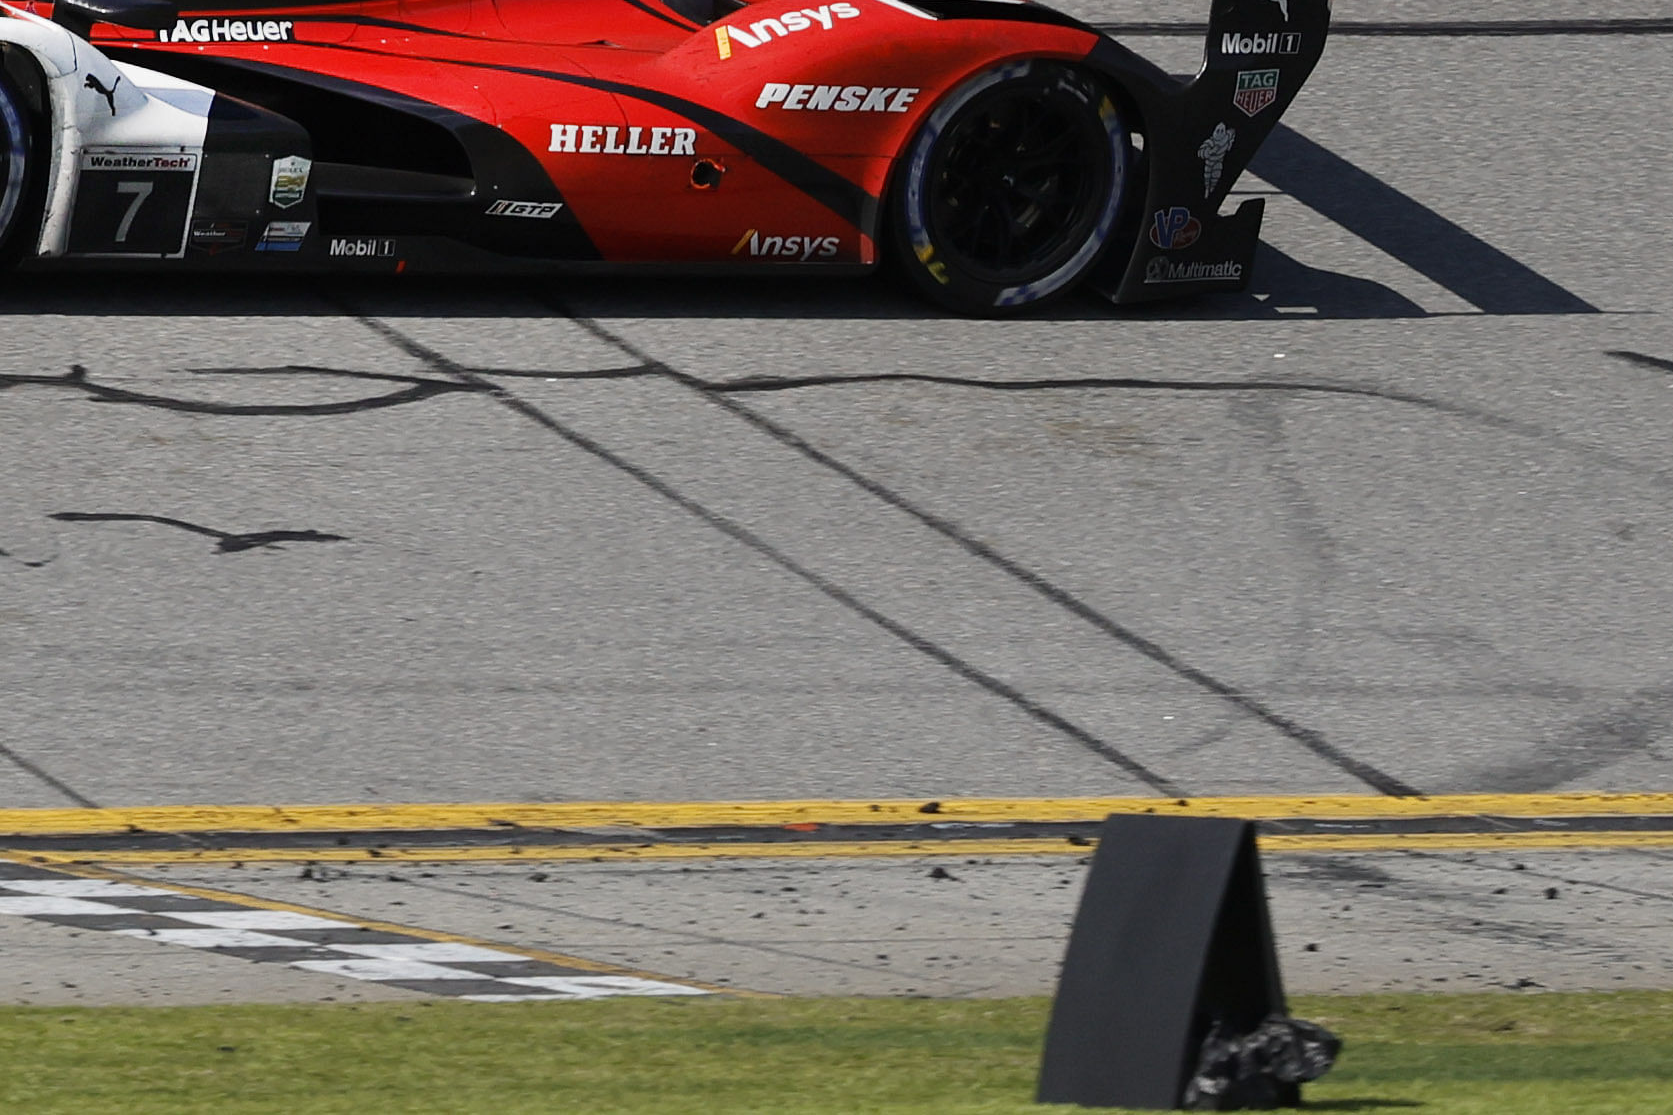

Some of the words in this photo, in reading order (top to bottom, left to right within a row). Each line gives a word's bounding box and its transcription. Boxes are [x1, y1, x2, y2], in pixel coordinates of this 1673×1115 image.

[715, 1, 861, 61] Ansys
[1221, 33, 1278, 54] Mobil
[1241, 72, 1275, 88] TAG
[754, 82, 920, 113] PENSKE
[1236, 90, 1274, 113] HEUER
[547, 123, 698, 156] HELLER
[90, 155, 191, 169] WeatherTech
[115, 181, 154, 243] 7
[510, 203, 557, 216] GTP
[1154, 206, 1191, 248] VP
[329, 238, 376, 257] Mobil
[730, 228, 840, 261] Ansys
[1168, 260, 1243, 279] Multimatic
